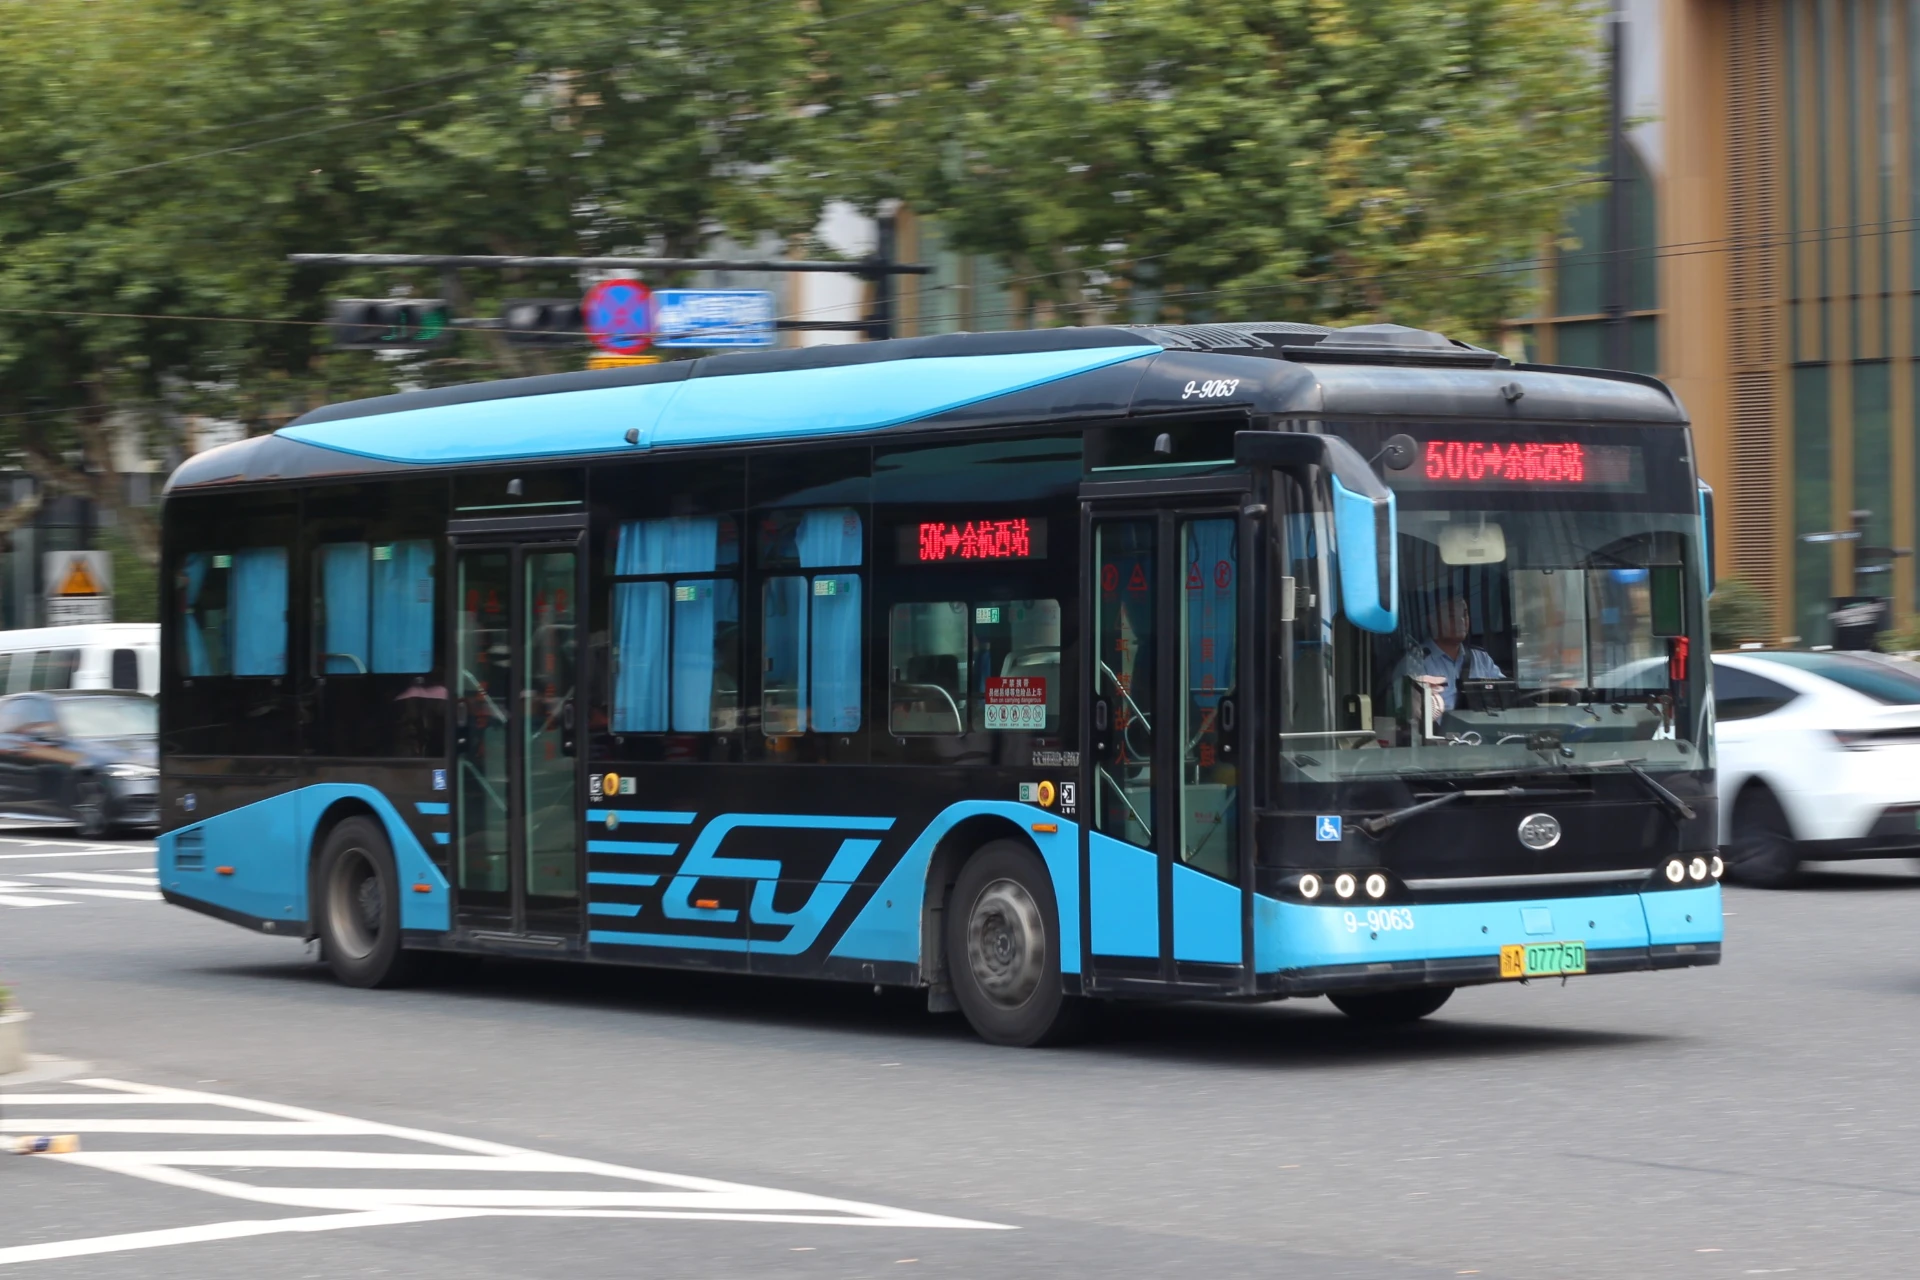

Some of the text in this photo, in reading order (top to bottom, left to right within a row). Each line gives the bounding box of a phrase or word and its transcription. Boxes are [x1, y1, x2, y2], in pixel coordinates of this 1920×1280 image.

[1182, 379, 1239, 399] 9-9063
[1426, 441, 1584, 481] 506 余杭西站
[919, 518, 1030, 560] 506 余杭西站
[1343, 907, 1415, 933] 9-9063
